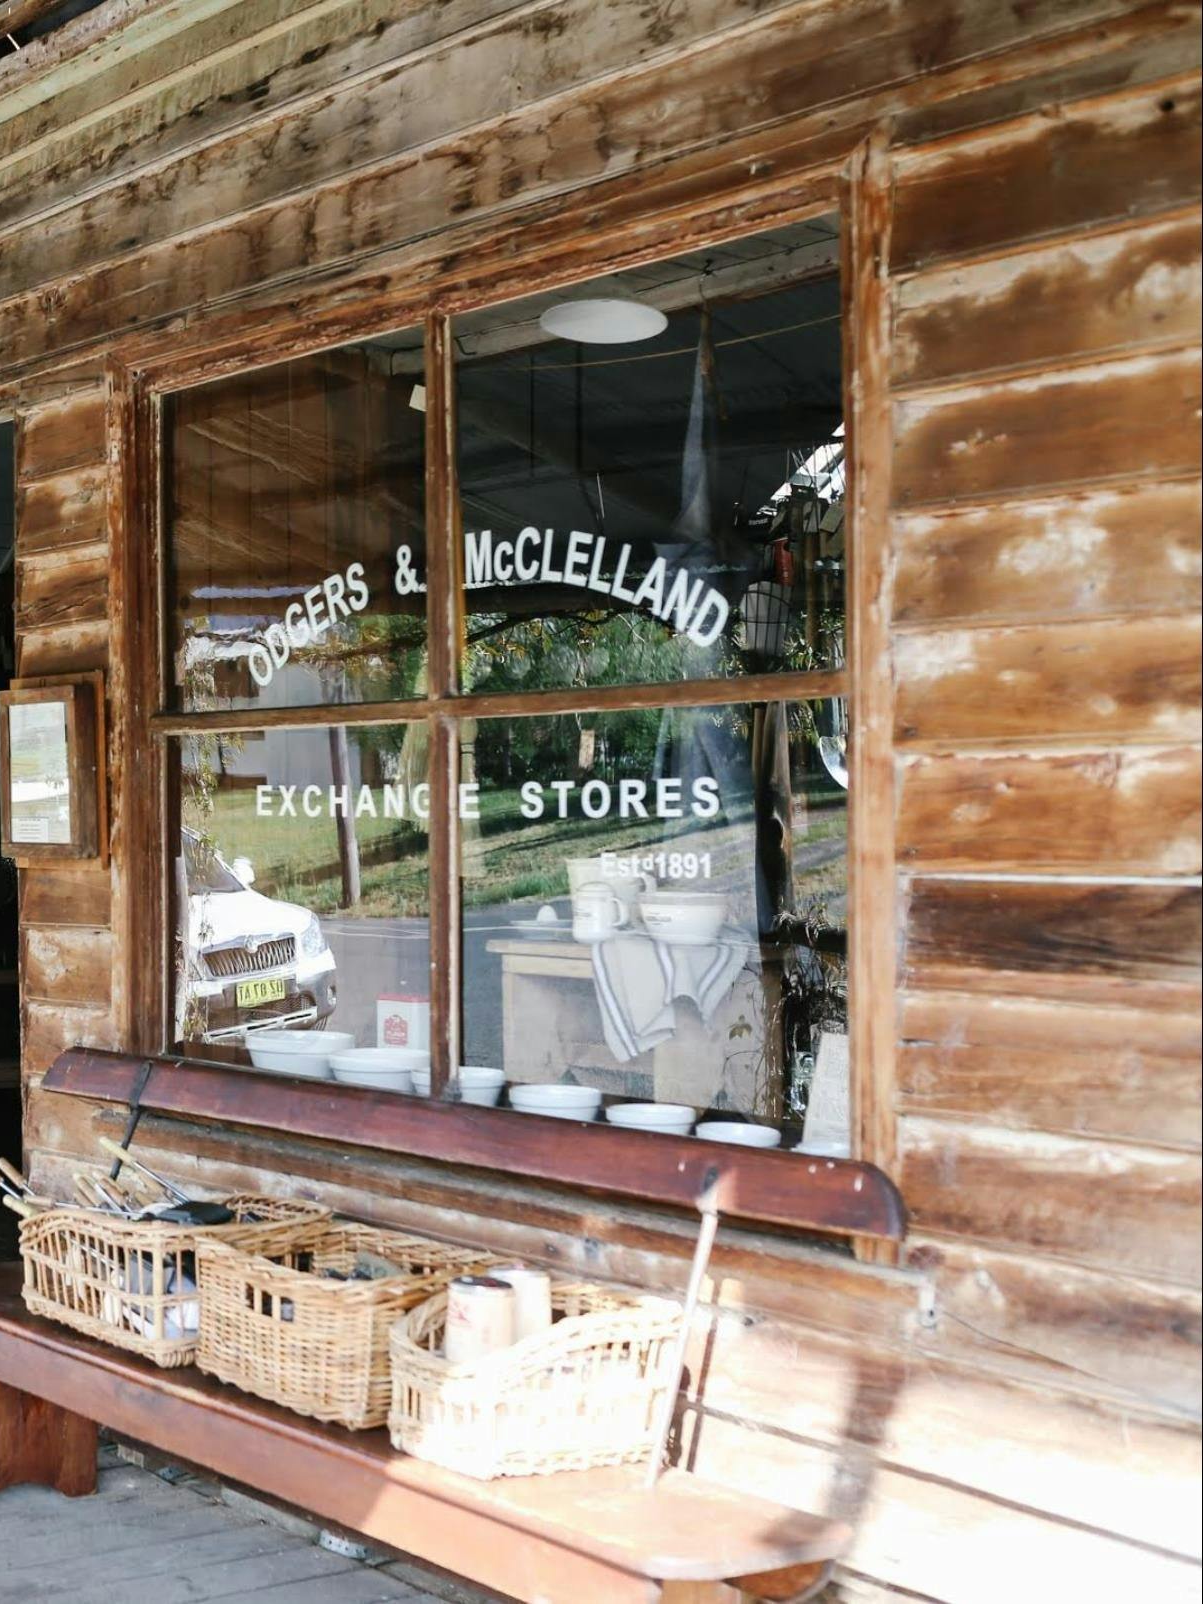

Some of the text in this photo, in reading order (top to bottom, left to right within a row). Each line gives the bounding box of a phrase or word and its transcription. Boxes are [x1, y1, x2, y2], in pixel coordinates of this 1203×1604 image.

[247, 526, 729, 687] ODGERS & McCLELLAND
[520, 776, 720, 819] STORES
